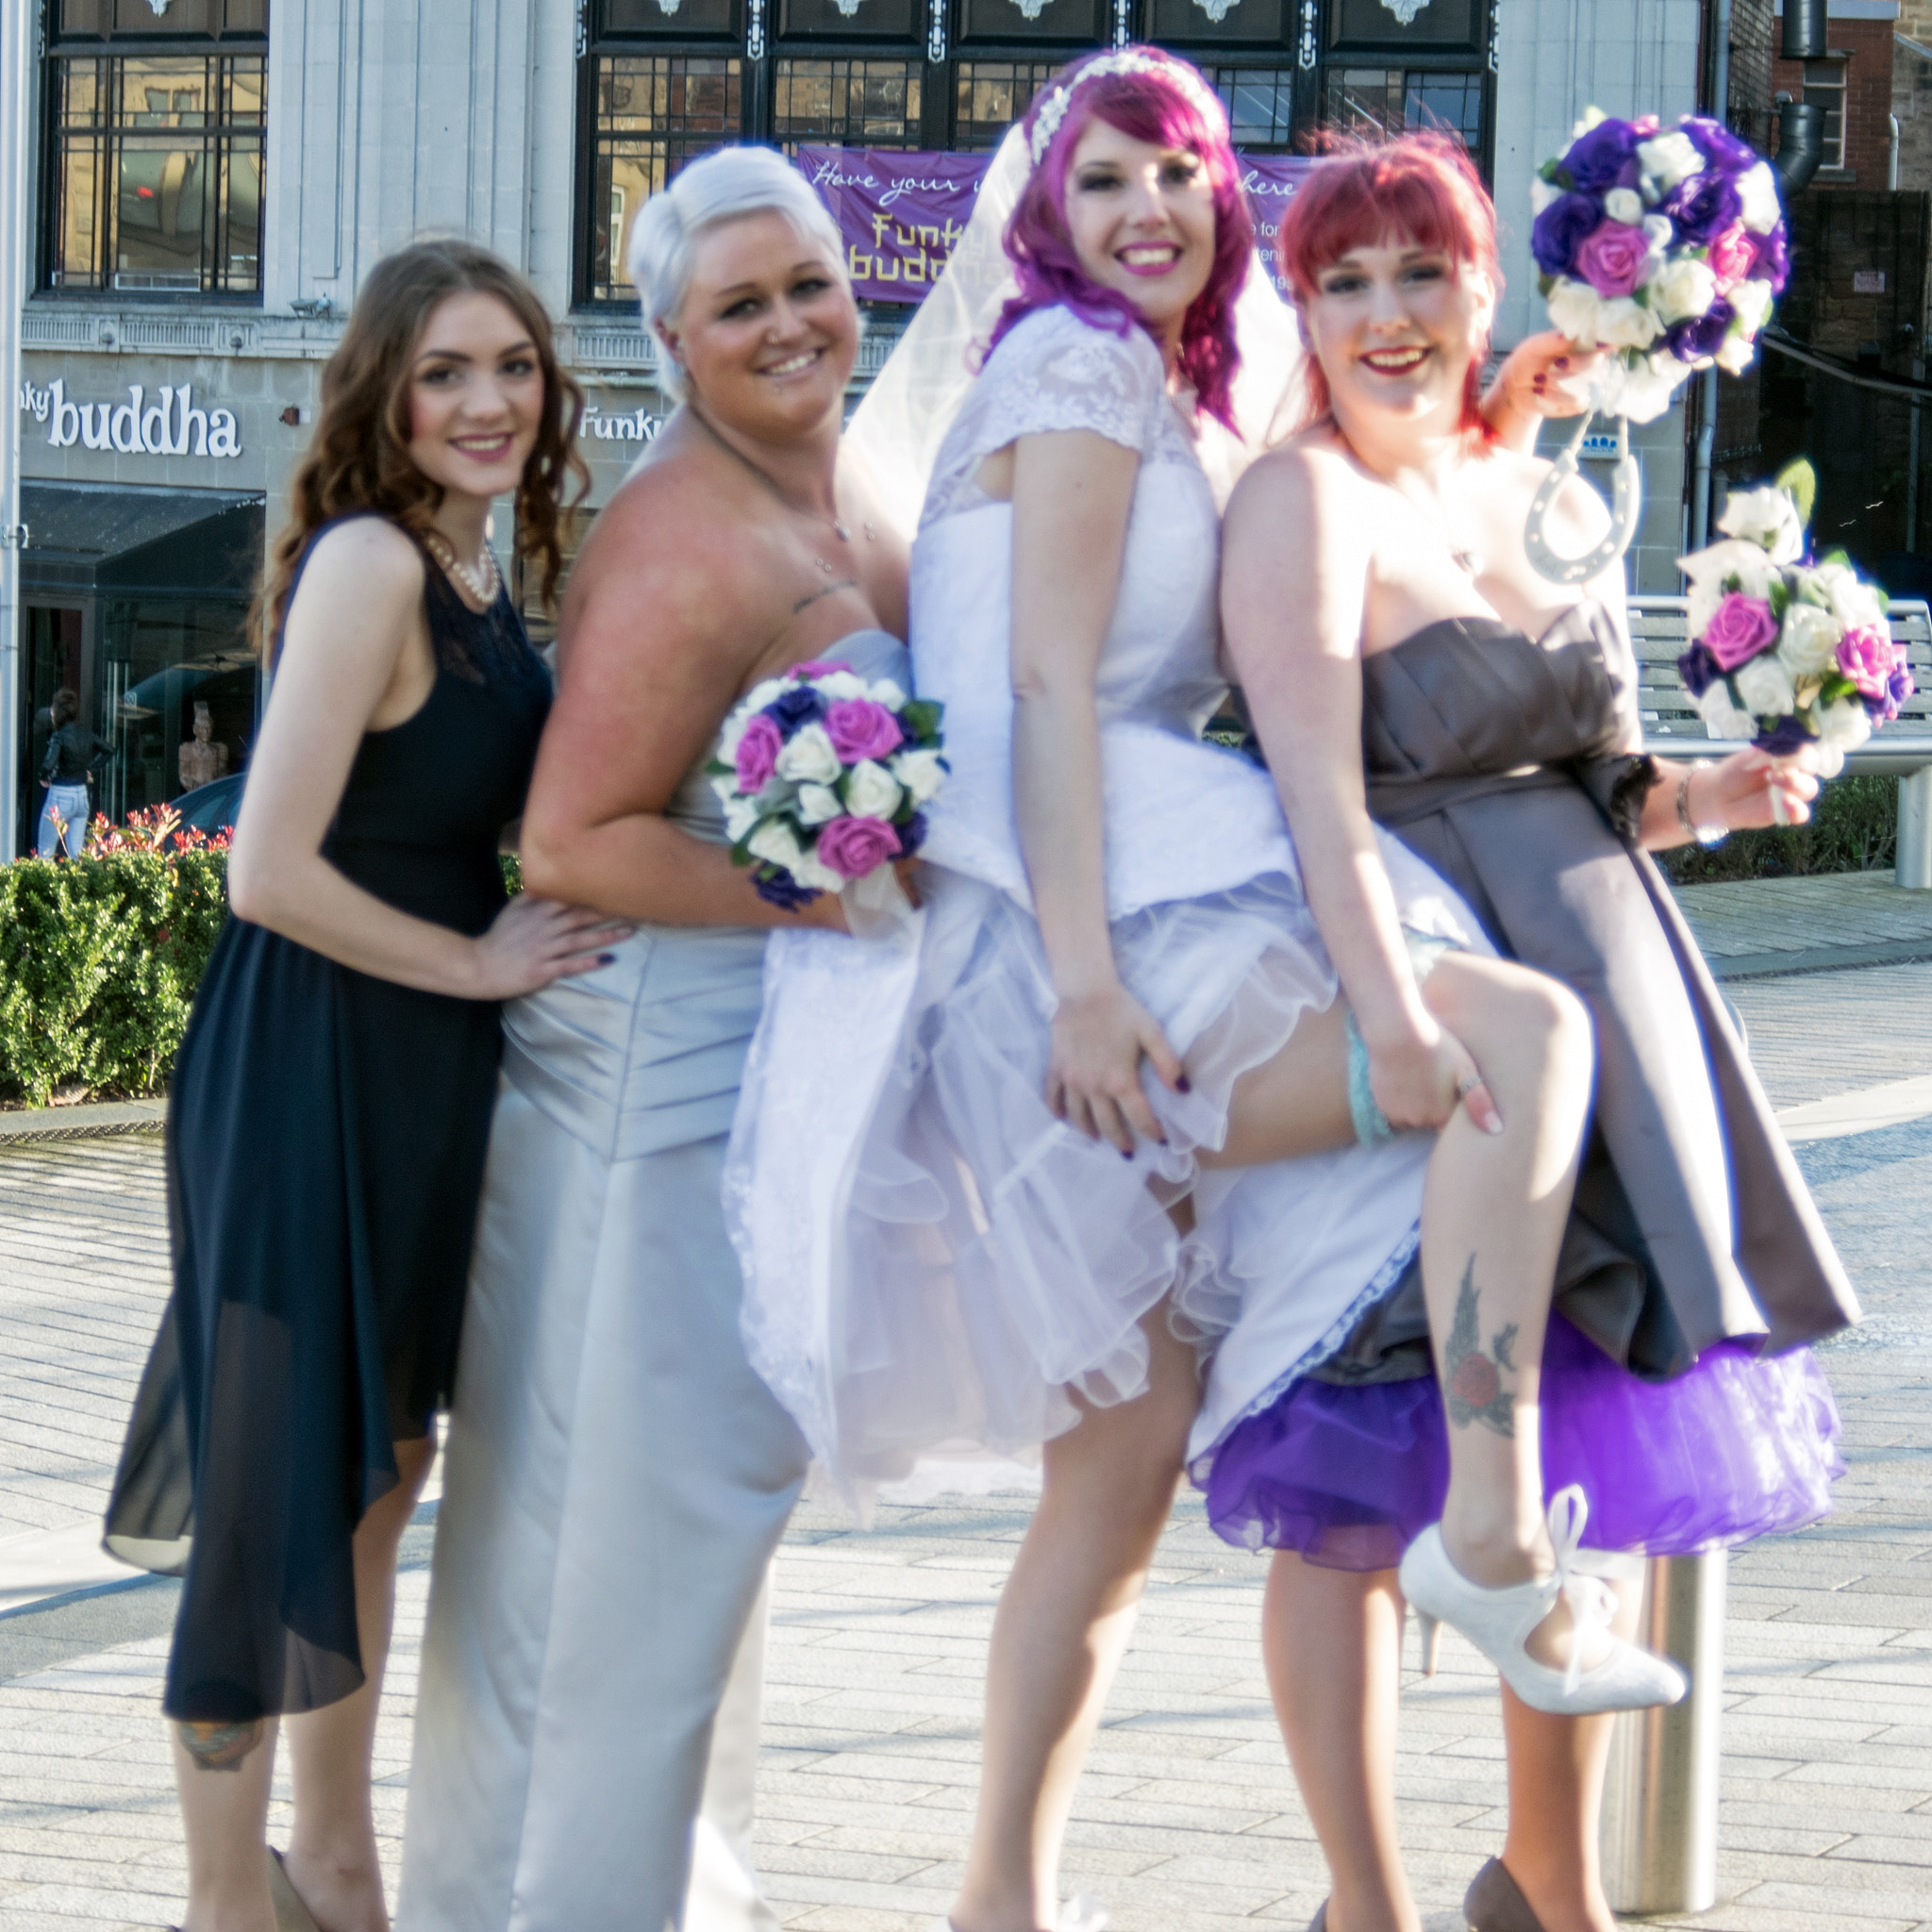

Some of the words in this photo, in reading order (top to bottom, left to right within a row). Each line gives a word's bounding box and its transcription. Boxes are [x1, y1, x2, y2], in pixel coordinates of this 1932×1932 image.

[812, 160, 879, 187] Have
[878, 176, 960, 207] your
[48, 377, 242, 458] buddha
